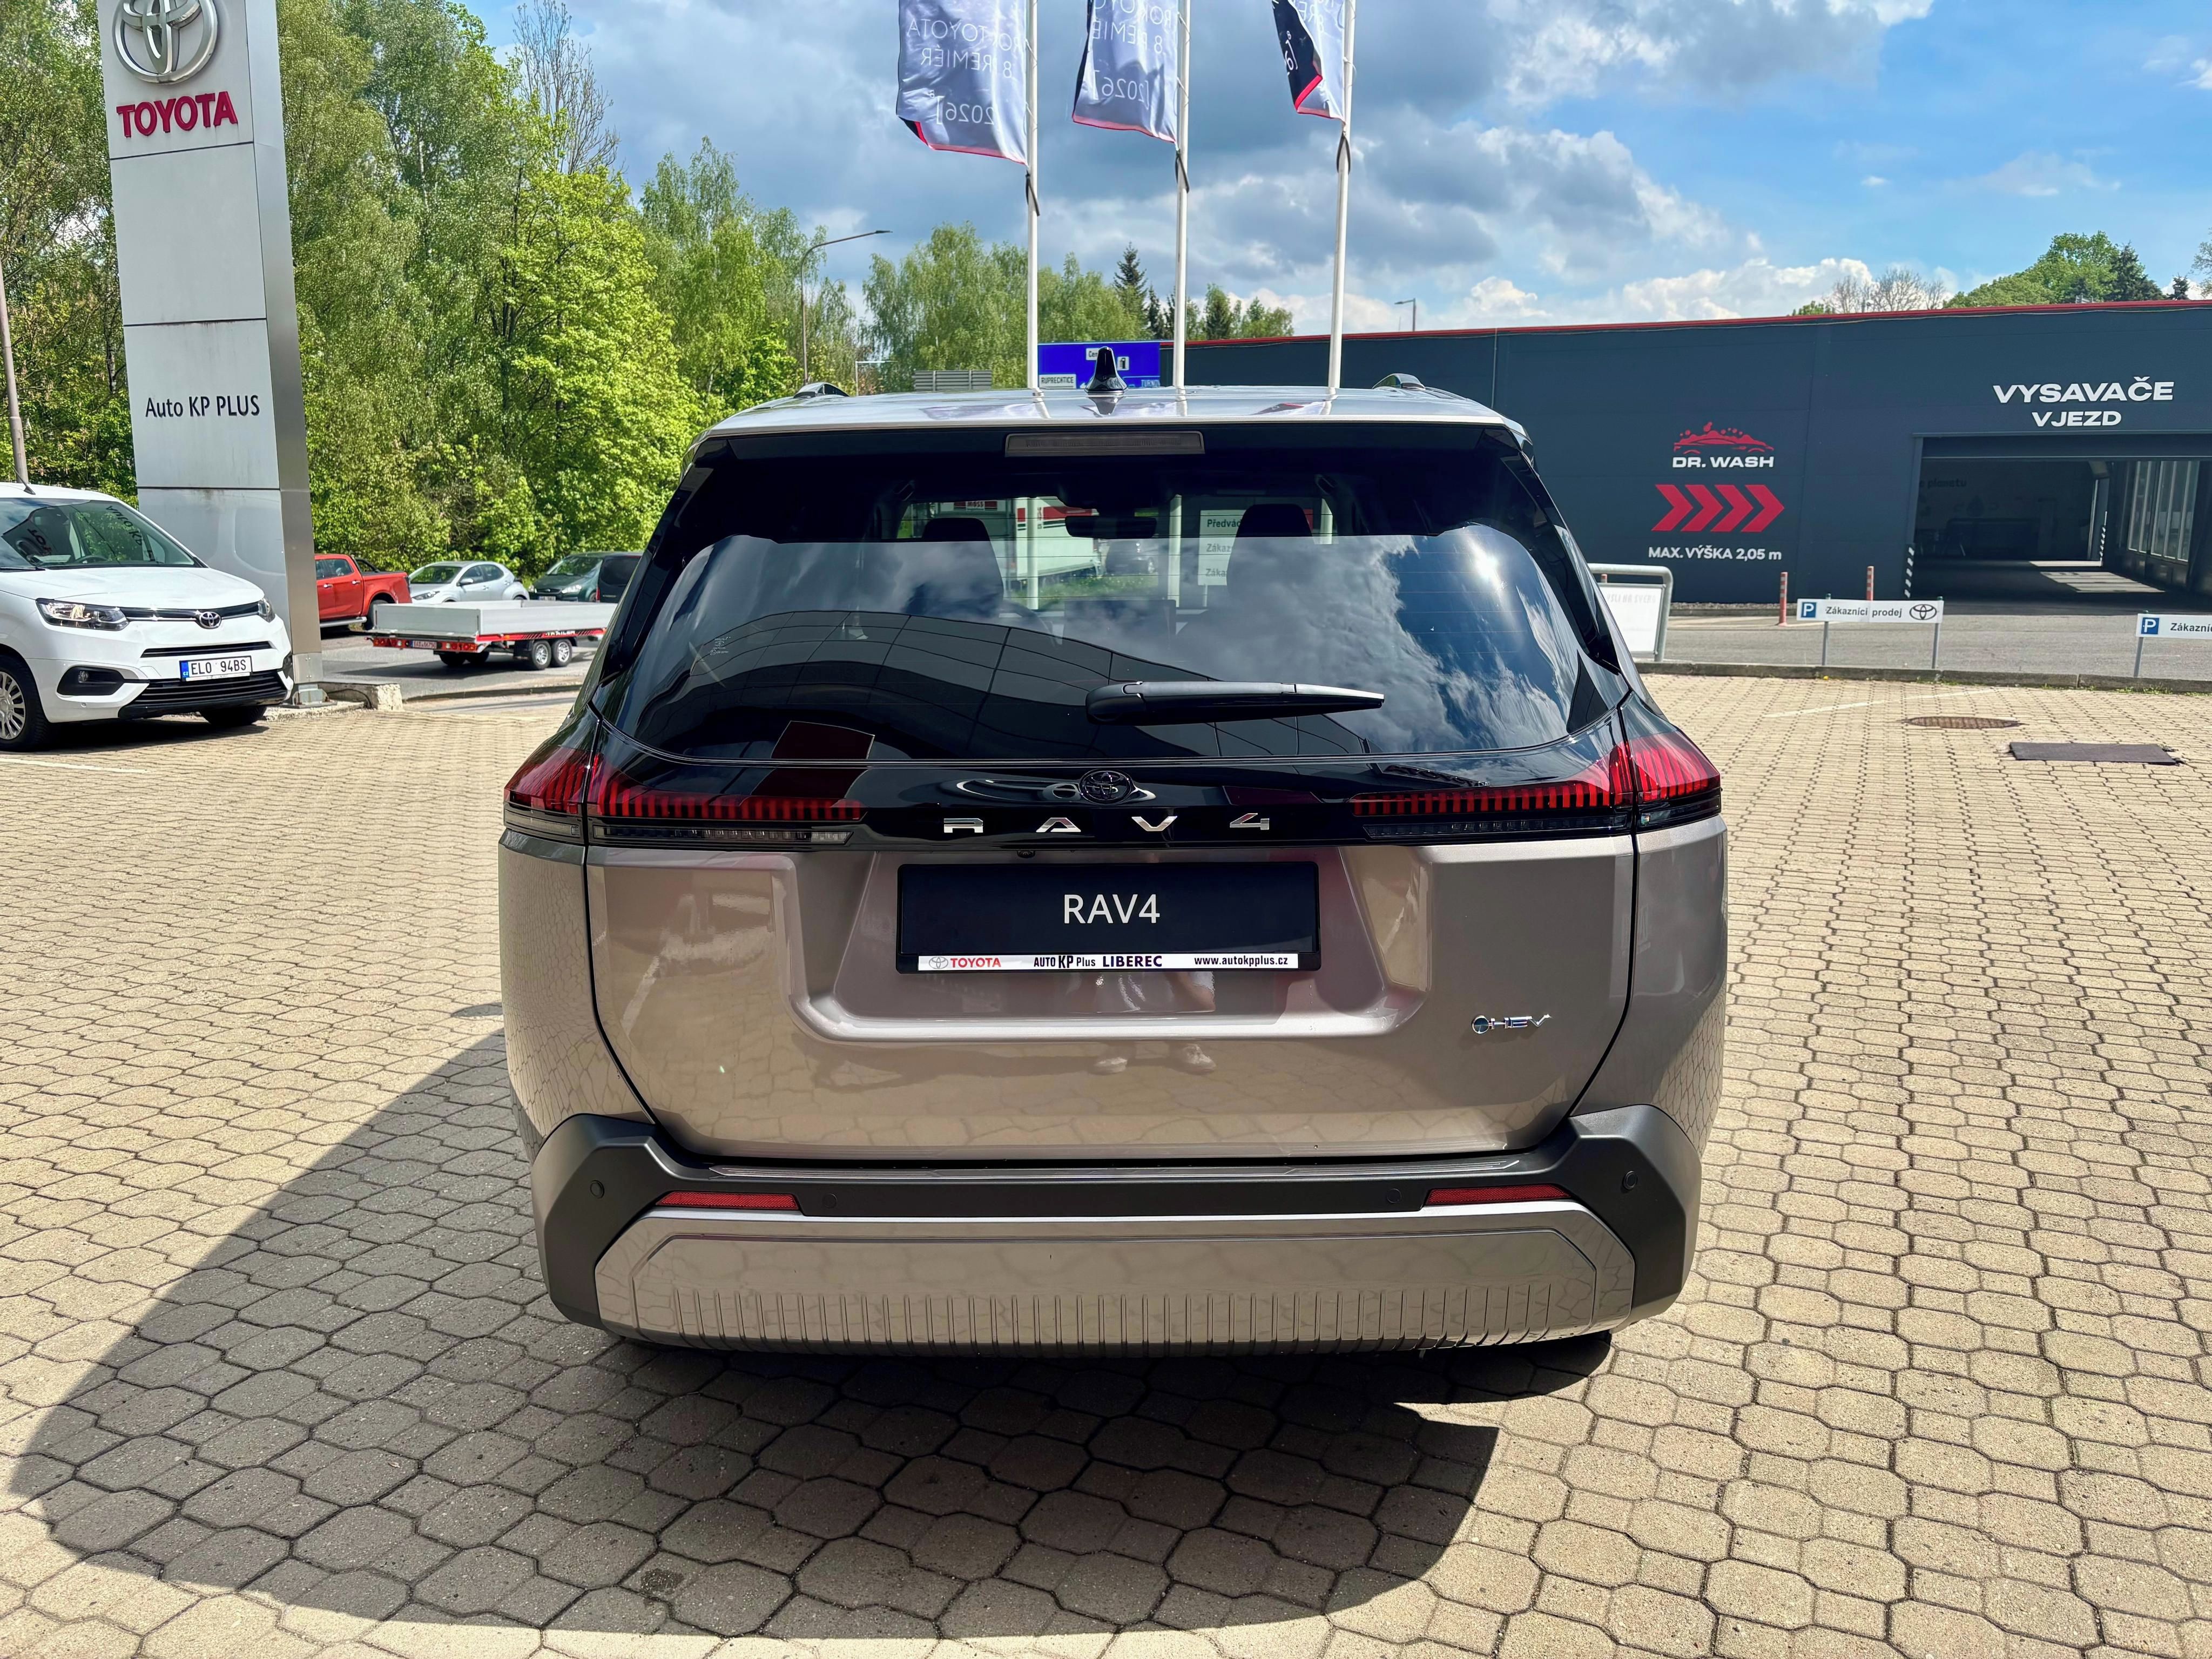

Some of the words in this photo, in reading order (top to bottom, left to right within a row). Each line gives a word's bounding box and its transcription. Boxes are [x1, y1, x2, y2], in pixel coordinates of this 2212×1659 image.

[116, 91, 238, 138] TOYOTA
[1993, 376, 2174, 403] VYSAVAČE
[145, 397, 184, 417] Auto
[189, 396, 210, 417] KP
[216, 394, 260, 416] PLUS
[2032, 410, 2122, 427] VJEZD
[1673, 456, 1706, 468] DR.
[1710, 456, 1775, 468] WASH
[1206, 543, 1232, 552] Zákaz
[1648, 547, 1683, 558] MAX.
[1685, 545, 1732, 559] VÝŠKA
[1736, 549, 1765, 562] 2,05
[1769, 551, 1782, 560] m
[1205, 568, 1227, 577] Záka
[1826, 606, 1868, 616] Zákazníci
[1872, 608, 1902, 618] prodej
[220, 659, 247, 672] 94BS
[943, 813, 1270, 833] RAV4
[1063, 893, 1161, 925] RAV4
[950, 957, 1002, 968] TOYOTA
[1034, 956, 1056, 968] AUTO
[1058, 955, 1074, 969] KP
[1076, 957, 1096, 967] Plus
[1103, 955, 1163, 968] LIBEREC
[1194, 955, 1289, 967] www.autokpplus.cz
[1491, 1014, 1553, 1030] HEV
